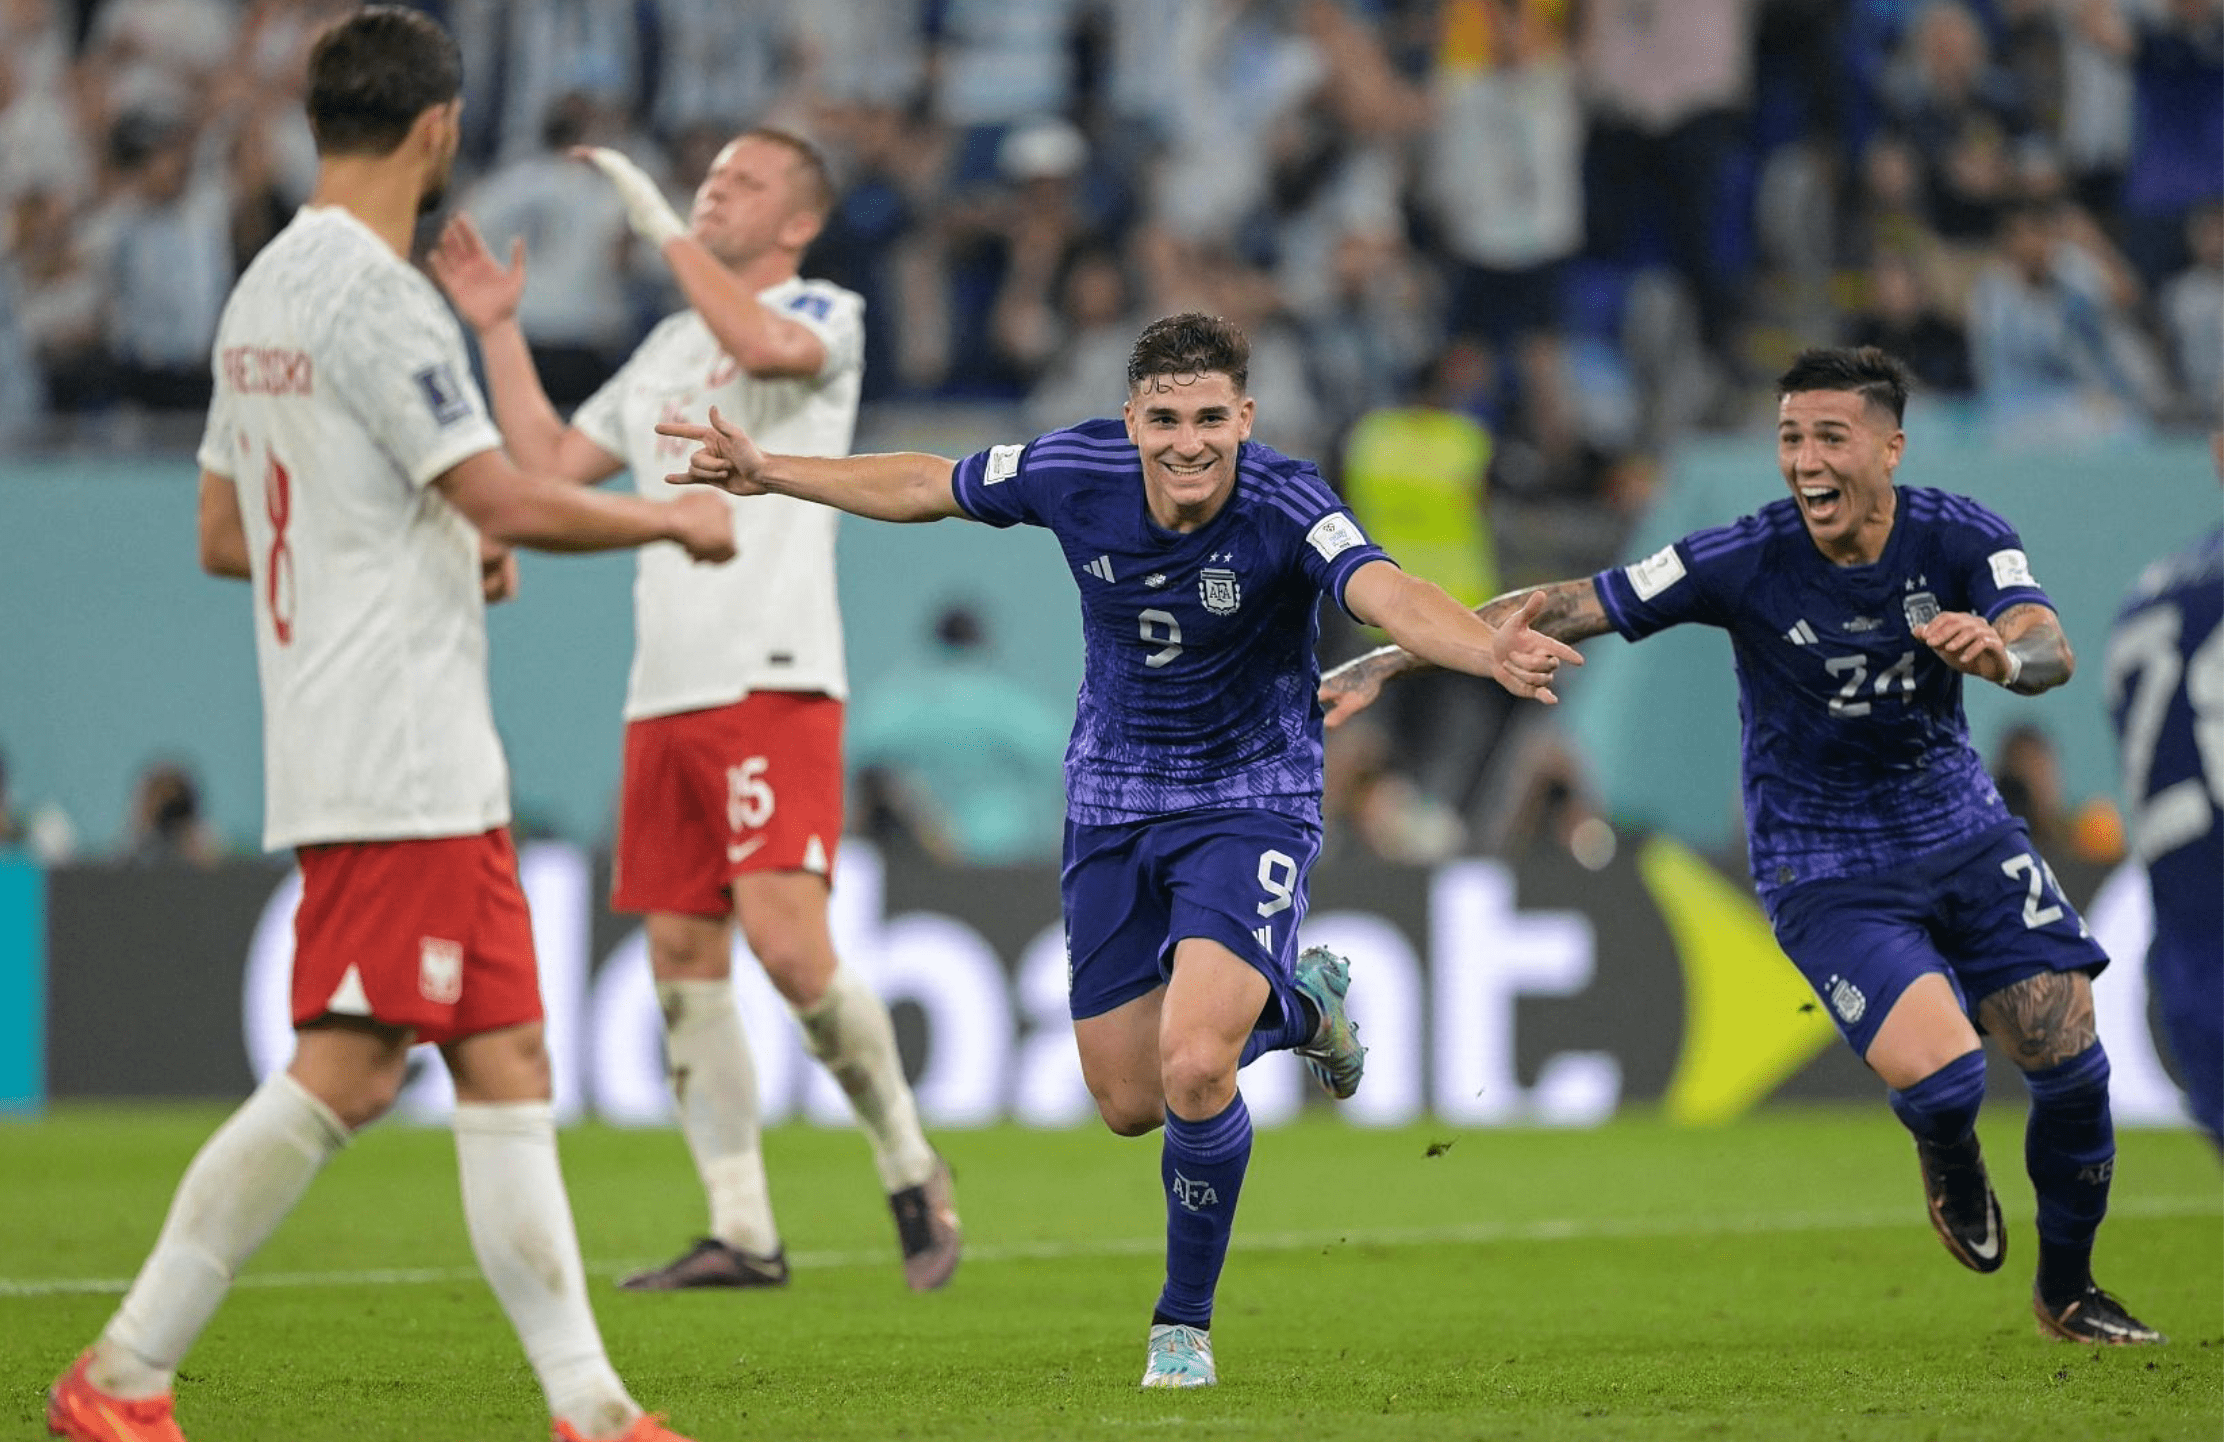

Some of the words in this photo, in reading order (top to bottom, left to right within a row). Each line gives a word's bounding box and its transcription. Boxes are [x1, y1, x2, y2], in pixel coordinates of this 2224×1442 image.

[1209, 581, 1232, 603] AFA
[1138, 608, 1184, 668] 9
[727, 755, 775, 833] 15
[1257, 849, 1298, 919] 9
[1173, 1168, 1219, 1211] AFA
[2077, 1158, 2114, 1186] AF
